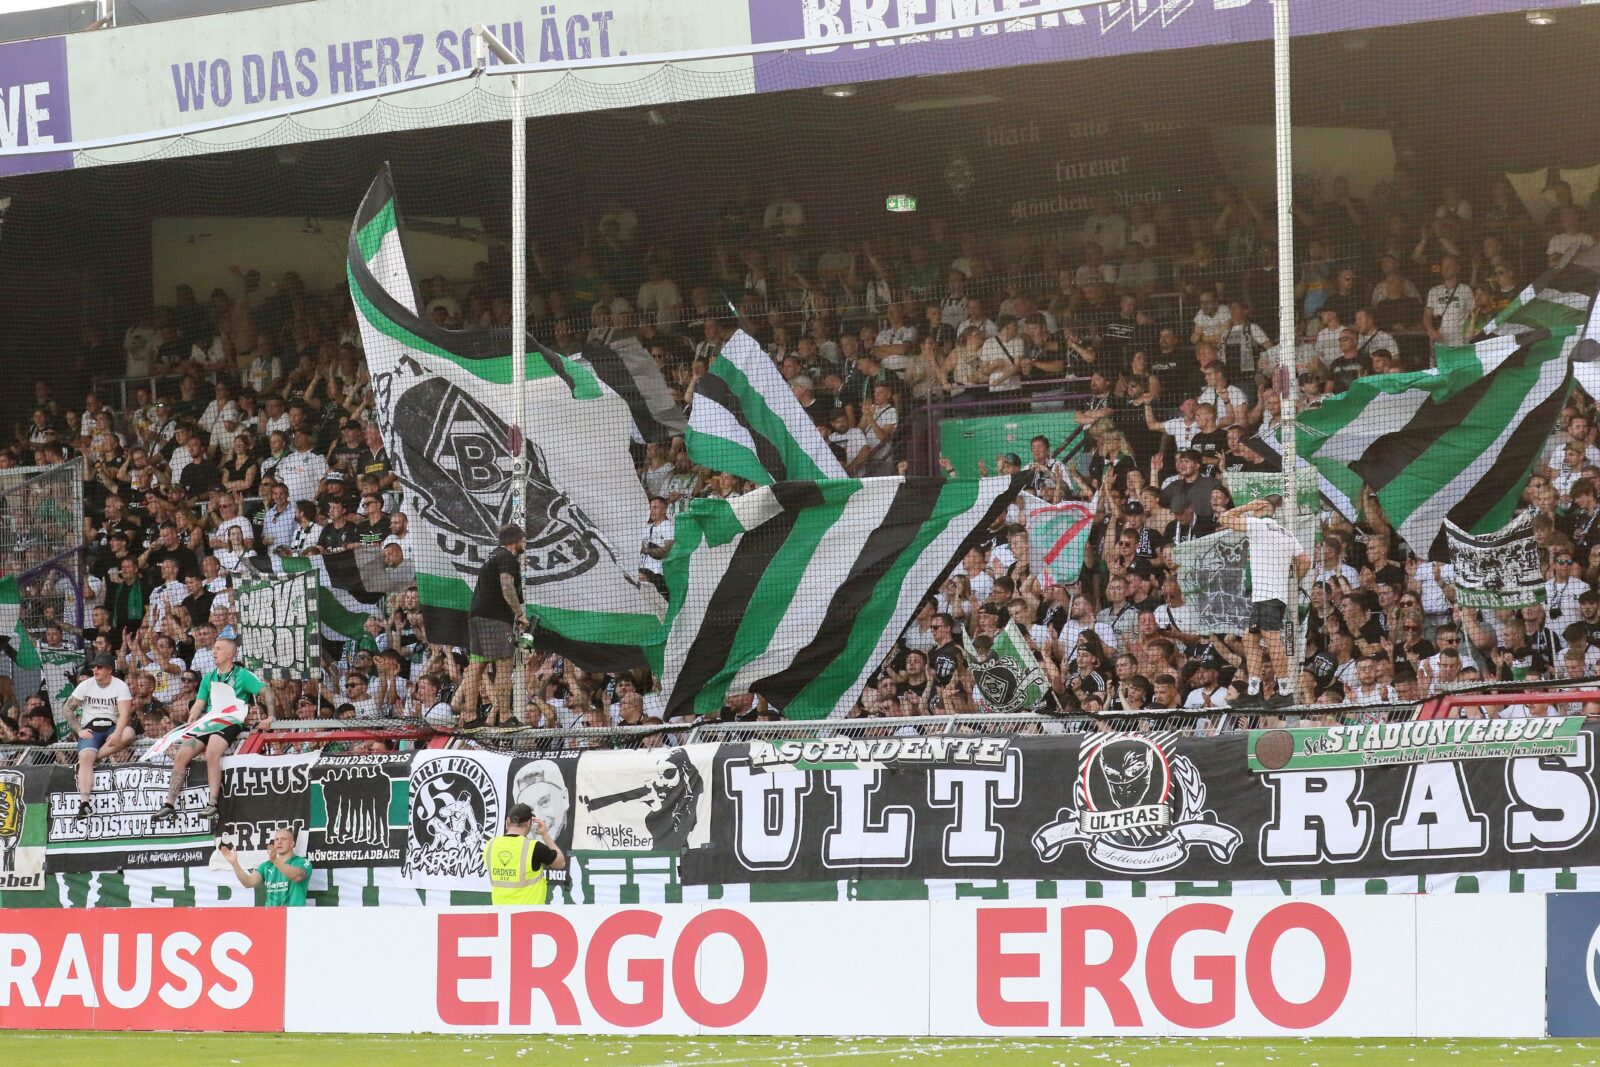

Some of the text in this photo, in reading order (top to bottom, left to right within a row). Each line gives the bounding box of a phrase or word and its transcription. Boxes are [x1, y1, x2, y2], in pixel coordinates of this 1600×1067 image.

[171, 58, 233, 112] WO
[243, 47, 318, 104] DAS
[327, 33, 426, 94] HERZ
[1326, 716, 1568, 754] STADIONVERBOT
[750, 738, 1010, 767] ASCENDENTE
[76, 767, 188, 793] IR WOLLE
[219, 764, 310, 798] VITUS
[50, 816, 88, 841] ALS
[586, 823, 633, 837] rabauke
[1089, 807, 1160, 830] ULTRAS
[308, 848, 400, 862] MÖNCHENGLADBACH
[492, 867, 517, 877] ORDNER
[0, 931, 254, 1010] RAUSS
[437, 909, 768, 1028] ERGO
[976, 902, 1352, 1029] ERGO
